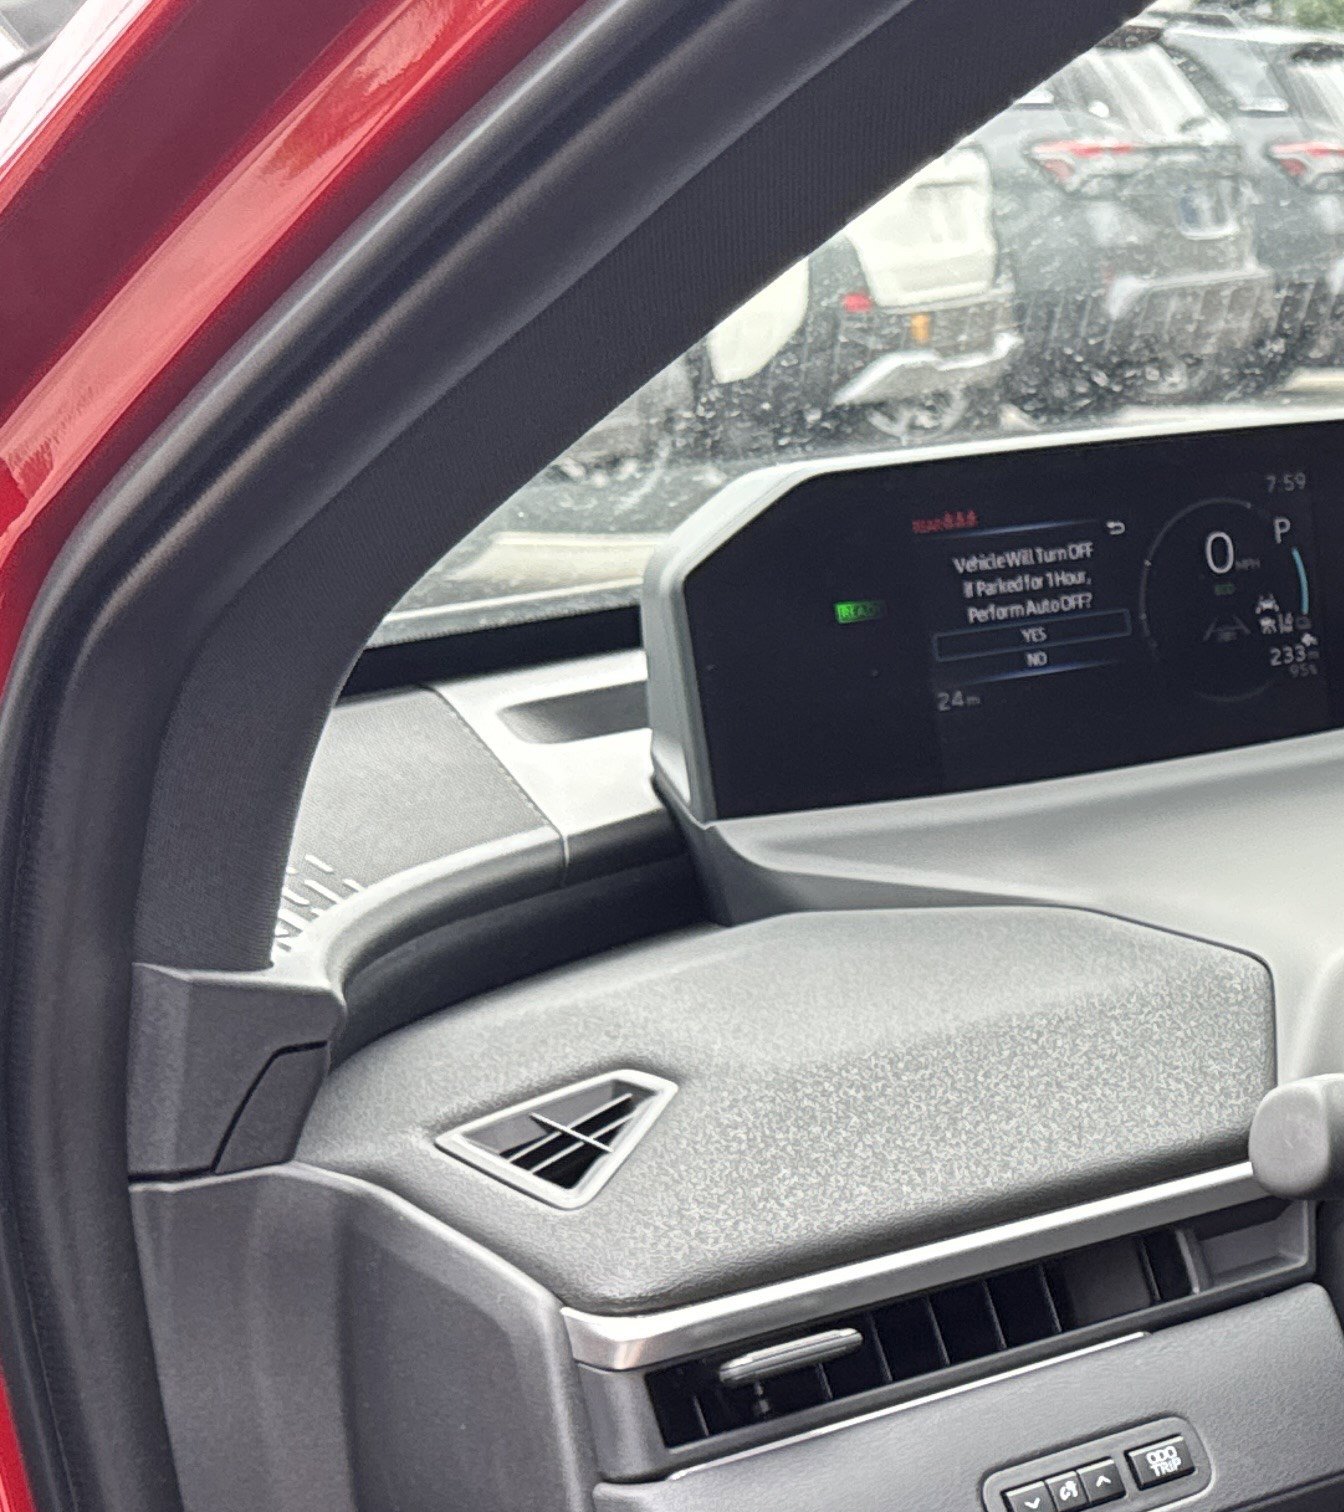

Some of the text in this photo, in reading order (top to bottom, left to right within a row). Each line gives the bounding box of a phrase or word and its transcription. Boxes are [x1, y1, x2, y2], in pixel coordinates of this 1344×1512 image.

[1266, 472, 1306, 493] 7:59
[1273, 516, 1291, 544] P
[953, 541, 1093, 574] Vehicle Will Turn OFF
[1206, 531, 1234, 574] 0
[976, 574, 1023, 597] Parked
[1024, 574, 1043, 591] for
[1047, 573, 1054, 587] 1
[967, 592, 1093, 624] Perform Auto OFF?
[1021, 627, 1047, 643] YES
[1026, 651, 1048, 667] NO
[1269, 644, 1306, 667] 233
[937, 690, 964, 711] 24
[1146, 1445, 1178, 1466] ODO
[1149, 1456, 1182, 1477] TRIP
